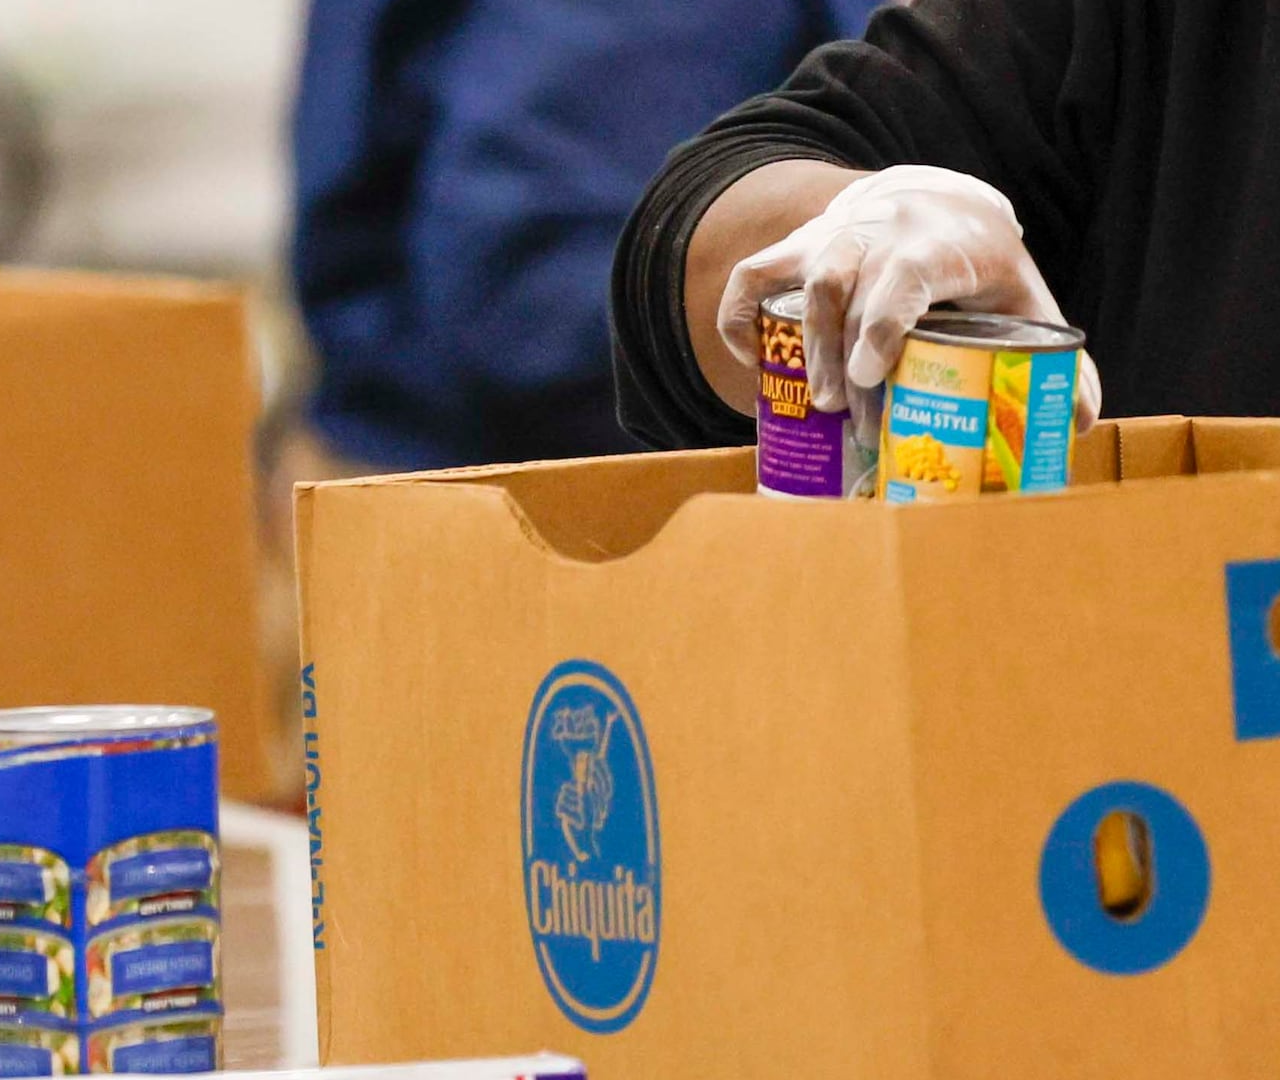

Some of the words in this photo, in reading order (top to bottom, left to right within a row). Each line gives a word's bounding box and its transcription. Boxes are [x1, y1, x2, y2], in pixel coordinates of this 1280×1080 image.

[762, 373, 813, 405] DAKOTA
[773, 402, 805, 417] PRIDE
[893, 403, 931, 427] CREAM
[934, 412, 979, 434] STYLE
[139, 899, 195, 916] KIRKLAND
[529, 859, 655, 963] Chiquita
[143, 996, 197, 1012] KIRKLAND
